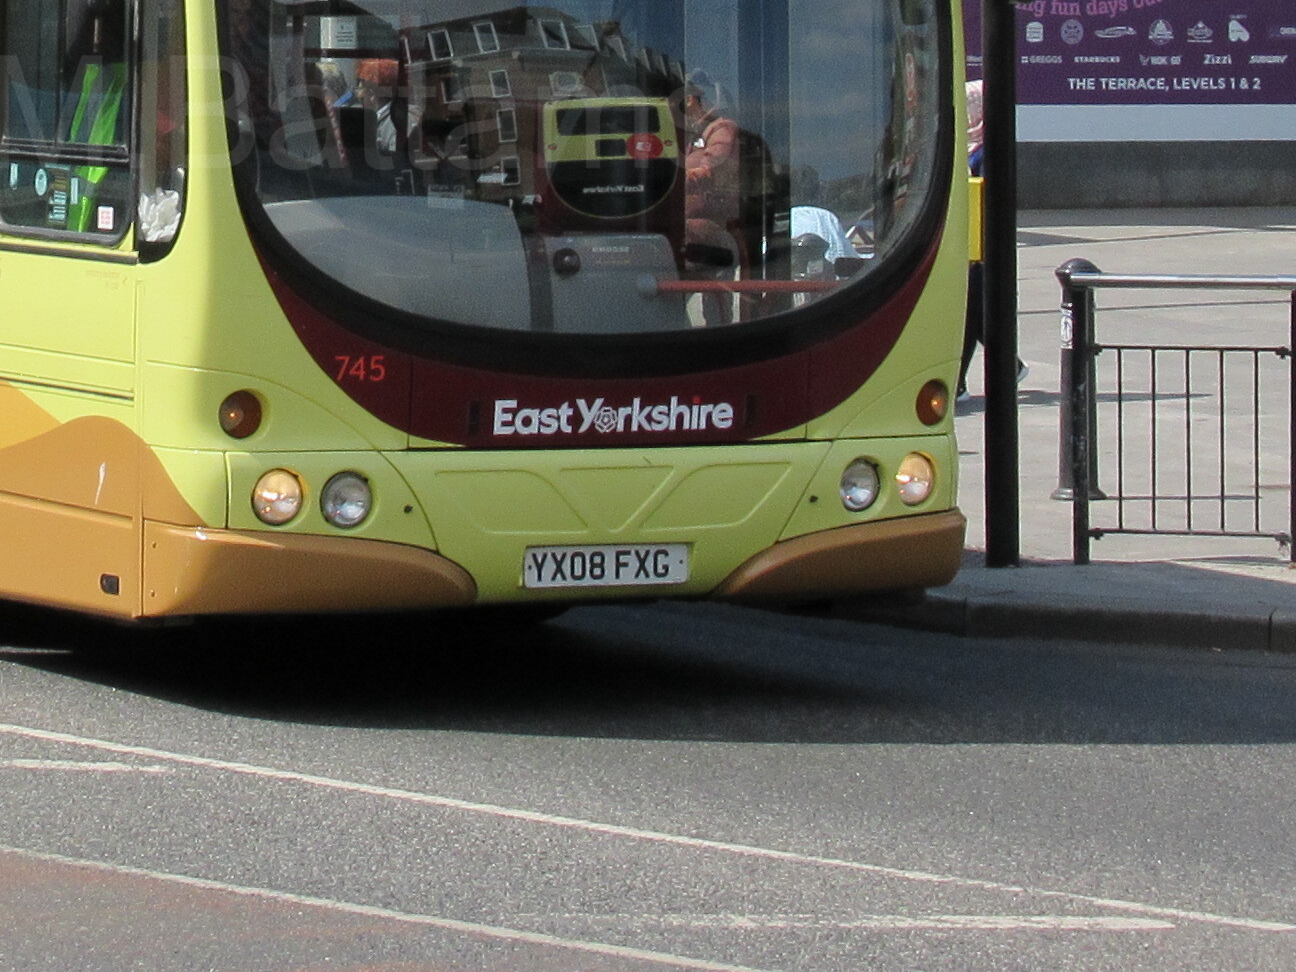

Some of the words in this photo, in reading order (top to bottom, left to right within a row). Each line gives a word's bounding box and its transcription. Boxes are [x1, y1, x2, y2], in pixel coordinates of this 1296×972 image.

[1203, 53, 1232, 65] Zizzi
[1067, 78, 1096, 90] THE
[1099, 78, 1169, 92] TERRACE,
[1173, 78, 1226, 90] LEVELS
[1230, 78, 1236, 90] 1
[1239, 78, 1250, 90] &
[1253, 78, 1262, 90] 2
[334, 355, 386, 382] 745
[493, 399, 573, 435] East
[576, 396, 734, 434] Yorkshire
[531, 549, 606, 582] YX08
[614, 549, 671, 579] FXG
